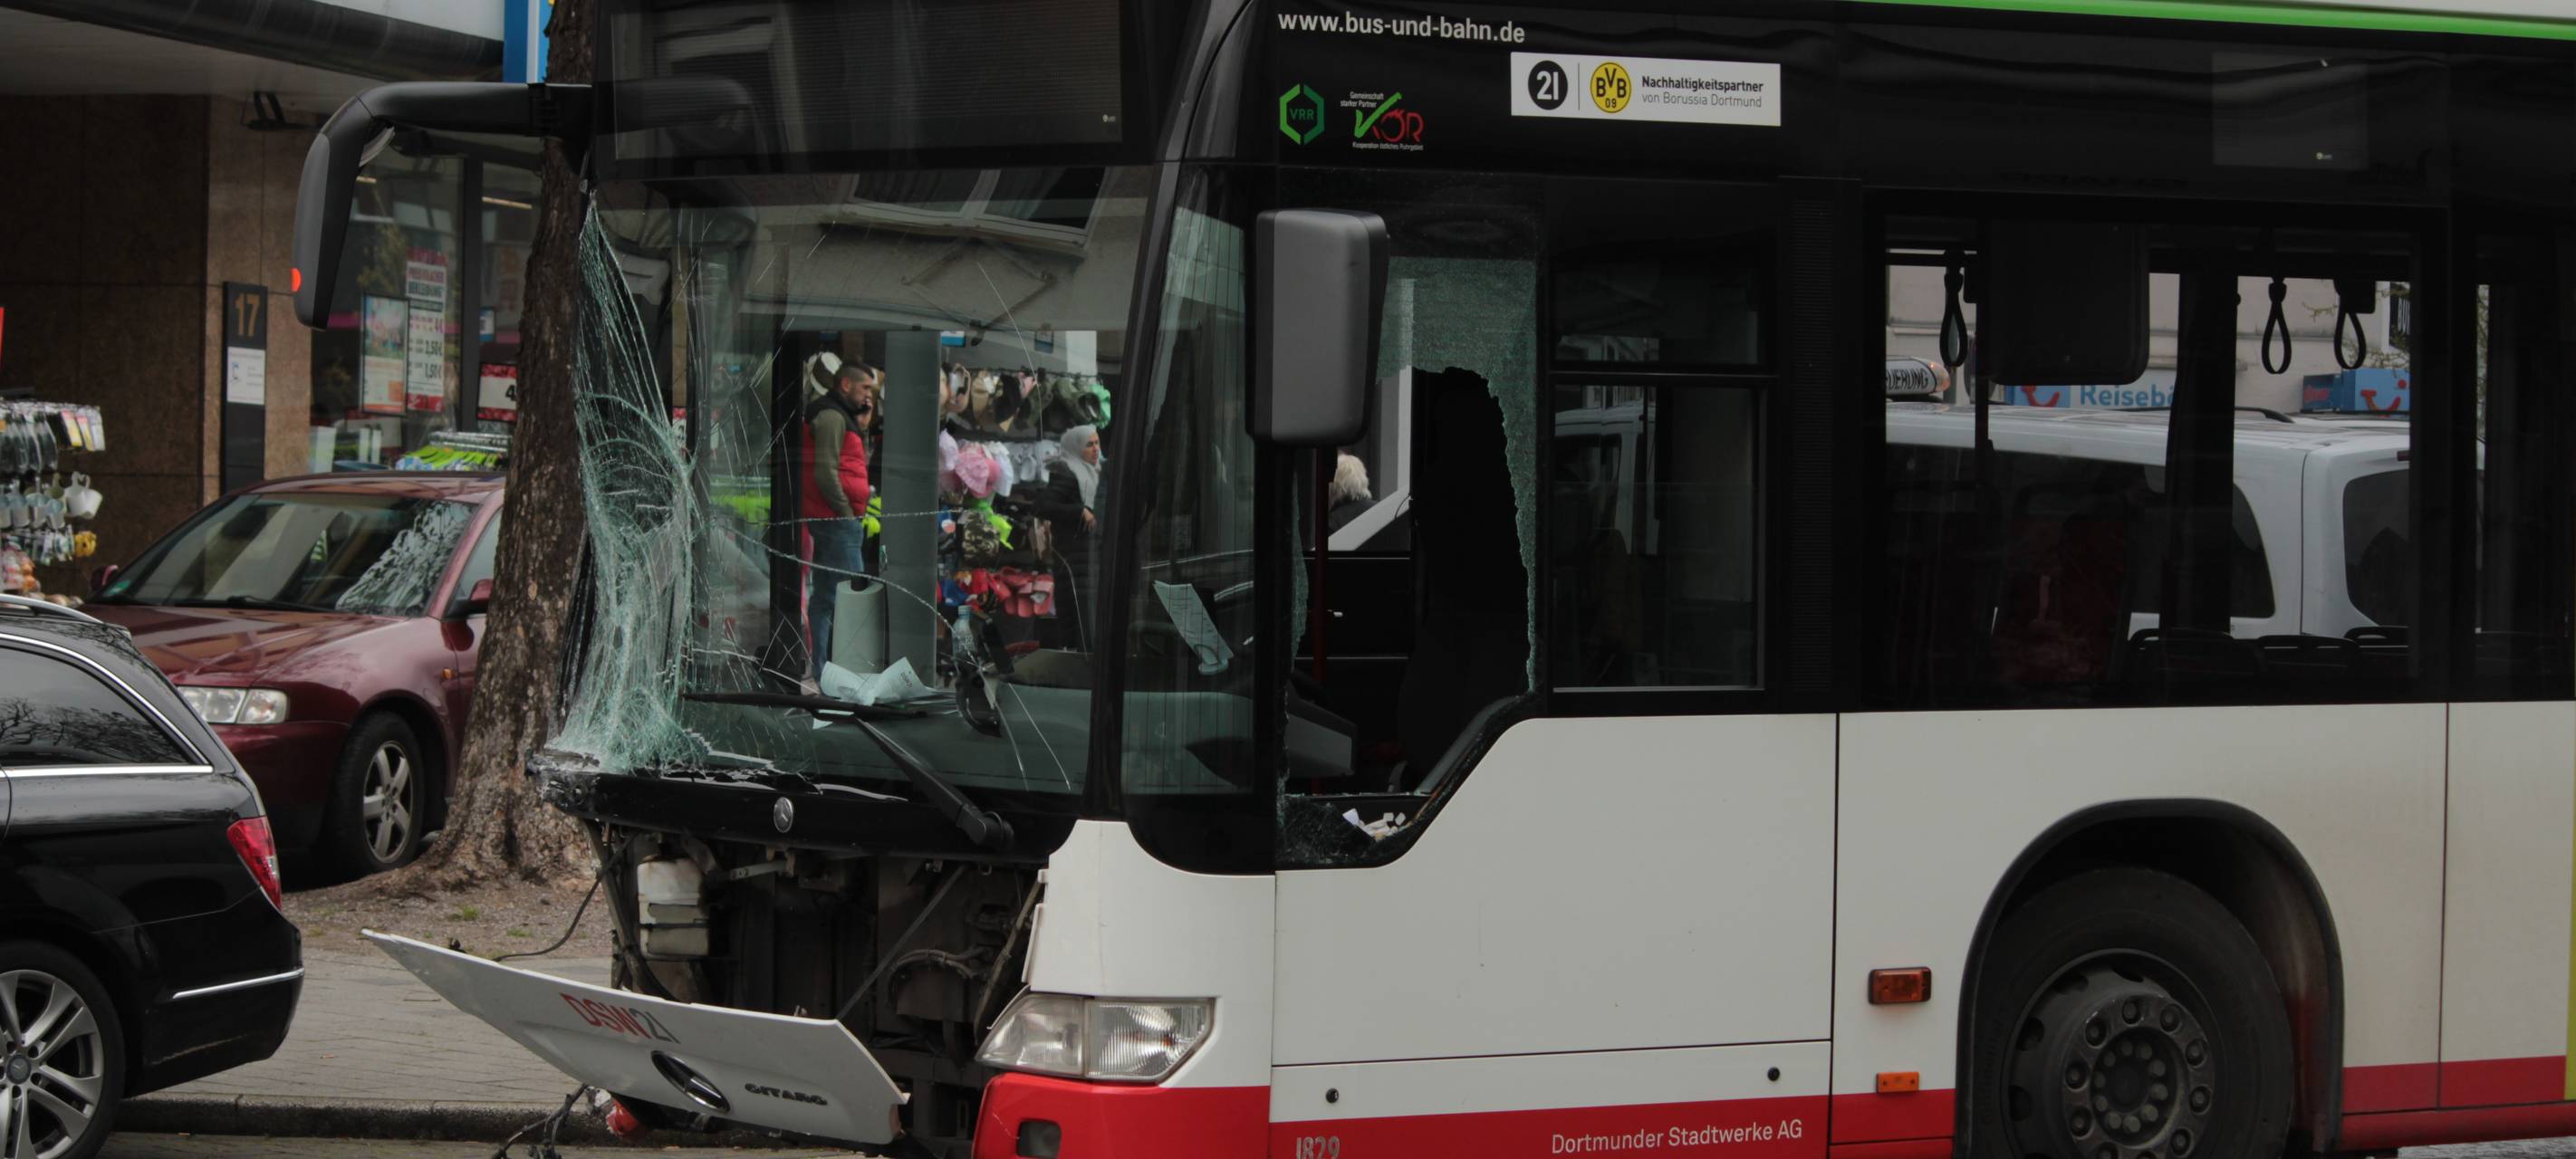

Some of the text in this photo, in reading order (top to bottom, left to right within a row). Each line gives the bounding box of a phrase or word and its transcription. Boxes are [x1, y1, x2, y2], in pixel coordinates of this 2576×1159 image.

[1278, 11, 1525, 43] www.bus-und-bahn.de
[1536, 70, 1559, 101] 21
[1596, 67, 1627, 99] BVB
[1641, 76, 1764, 93] Nachhaltigkeitspartner
[1350, 91, 1384, 101] Gemeinschaft
[1605, 98, 1617, 109] 09
[1641, 92, 1762, 108] von Borussia Dortmund
[1289, 108, 1313, 120] VRR
[235, 292, 260, 336] 17
[1886, 368, 1928, 390] UERUNG
[560, 992, 681, 1044] DSW21
[1295, 1135, 1341, 1159] 1829
[1552, 1119, 1802, 1154] Dortmunder Stadtwerke AG
